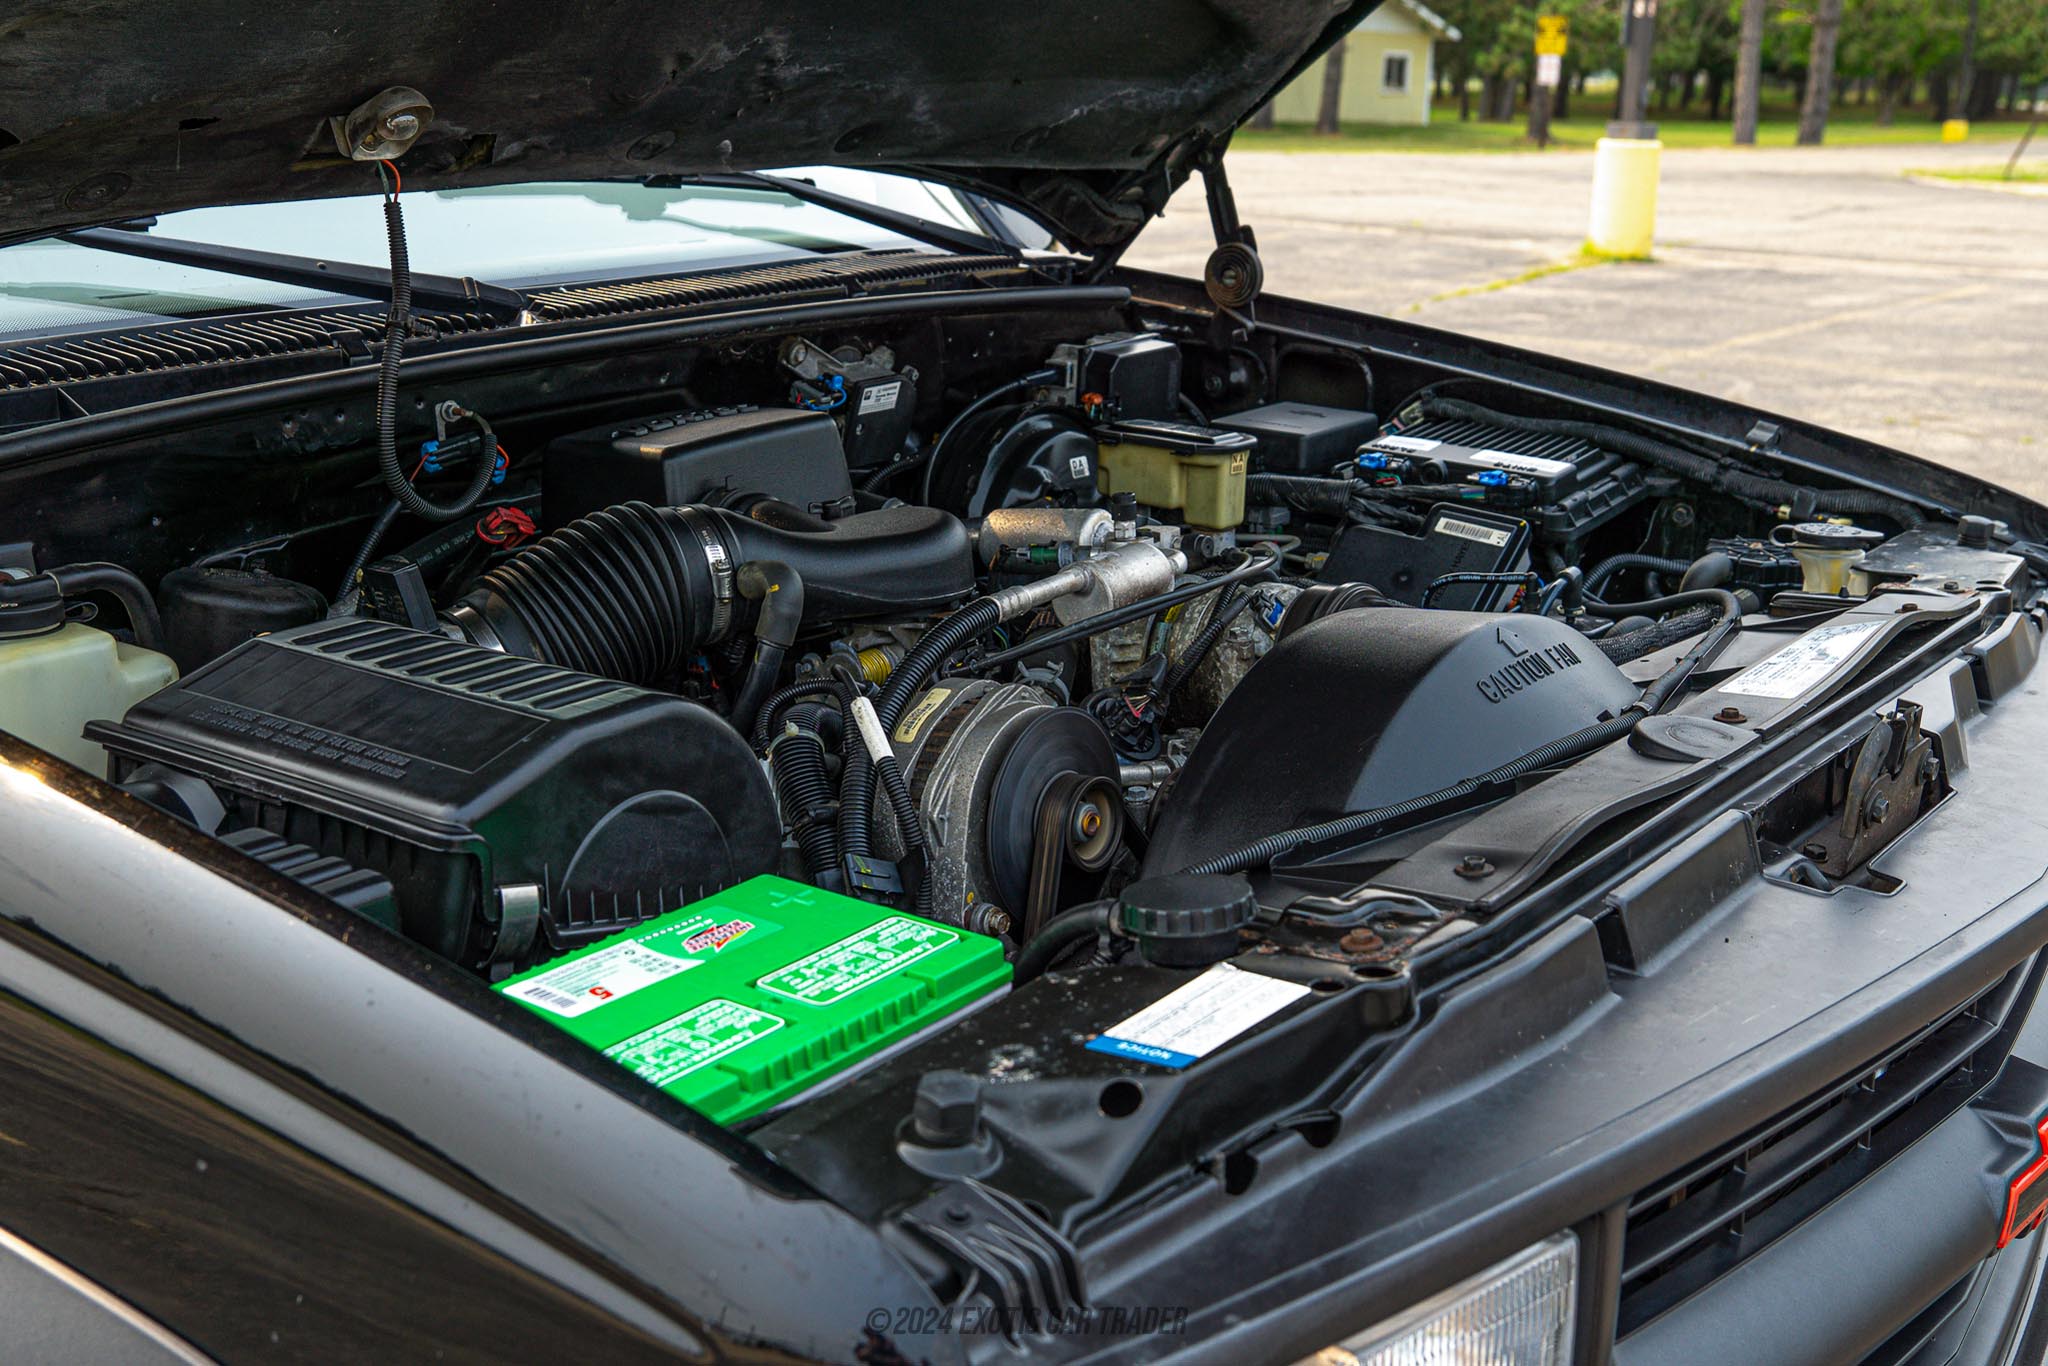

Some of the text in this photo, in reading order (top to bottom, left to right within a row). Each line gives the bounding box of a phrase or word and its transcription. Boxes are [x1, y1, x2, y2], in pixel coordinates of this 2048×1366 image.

[1477, 642, 1583, 704] CAUTION FAN
[588, 985, 614, 1000] 5
